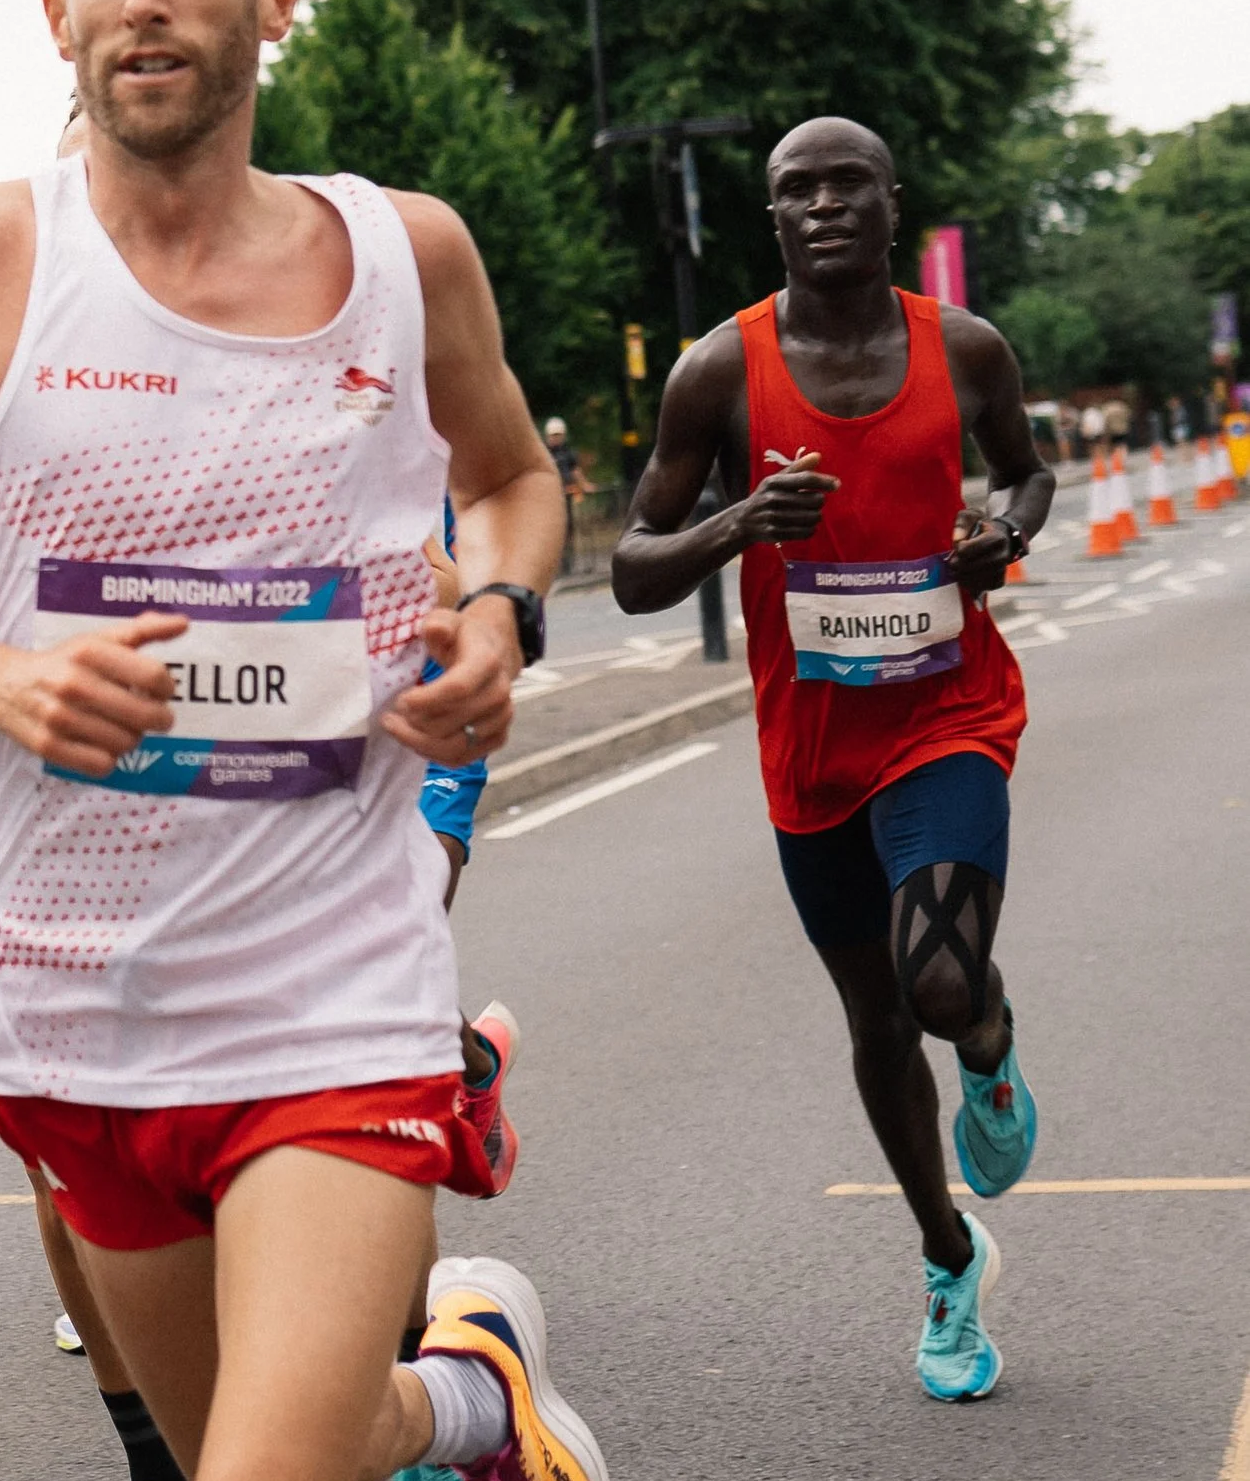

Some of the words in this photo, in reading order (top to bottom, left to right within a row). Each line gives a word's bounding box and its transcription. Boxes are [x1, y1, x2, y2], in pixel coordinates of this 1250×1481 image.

[65, 368, 177, 395] KUKRI
[101, 575, 254, 607] BIRMINGHAM
[255, 579, 311, 607] 2022
[815, 571, 896, 587] BIRMINGHAM
[897, 569, 930, 585] 2022
[819, 612, 931, 638] RAINHOLD
[164, 662, 288, 705] ELLOR
[173, 749, 310, 768] commonwealth
[210, 767, 273, 786] games
